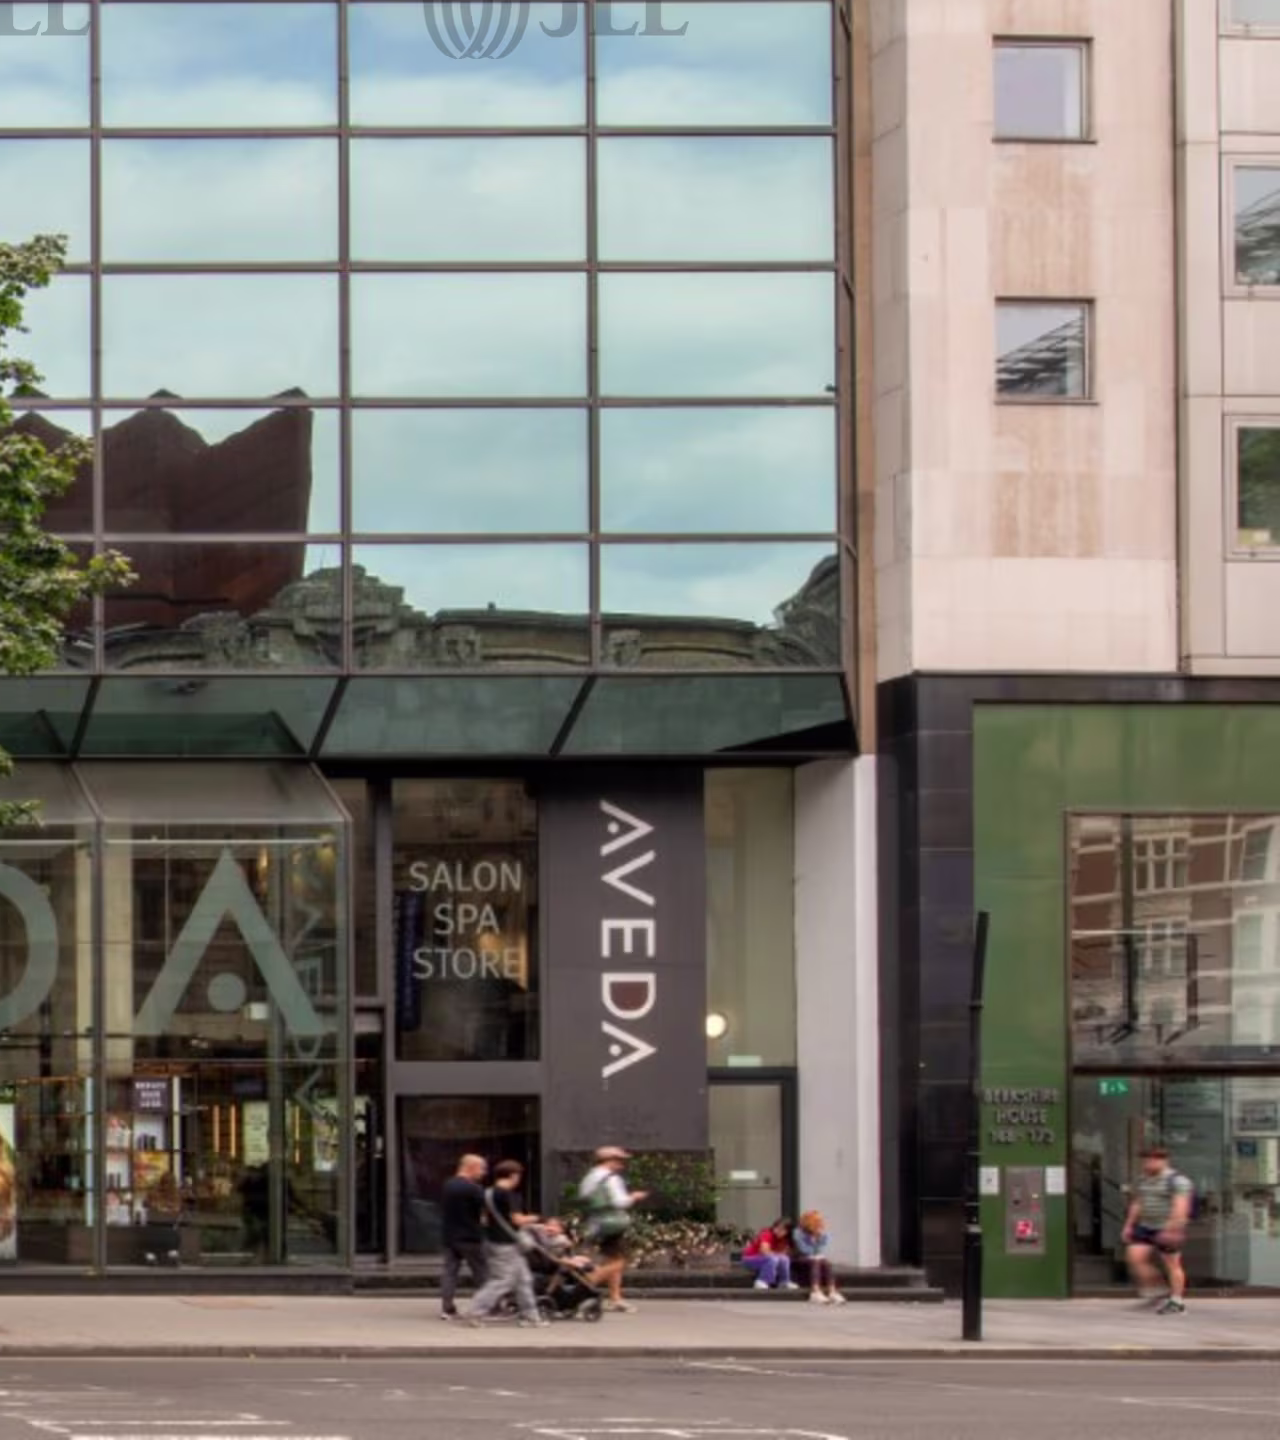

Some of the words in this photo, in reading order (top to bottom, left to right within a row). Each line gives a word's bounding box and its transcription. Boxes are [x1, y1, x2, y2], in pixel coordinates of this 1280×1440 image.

[409, 860, 522, 892] SALON
[433, 902, 500, 935] SPA
[600, 800, 657, 1078] AVEDA
[412, 947, 522, 979] STORE
